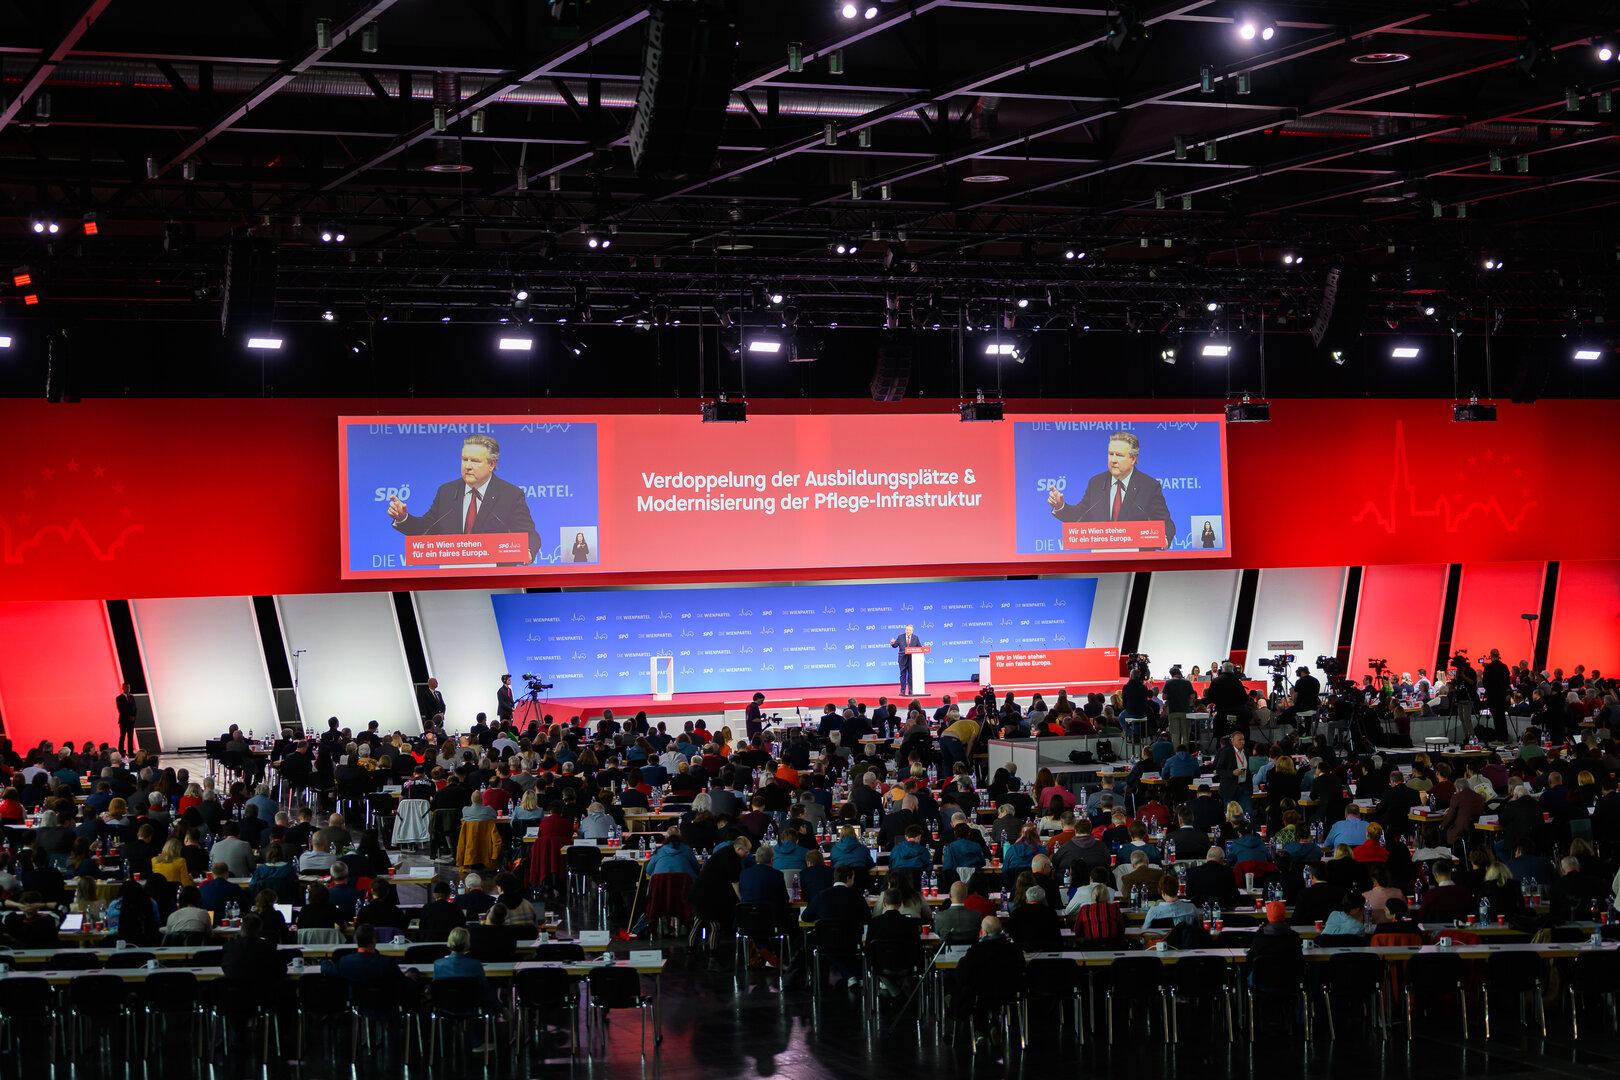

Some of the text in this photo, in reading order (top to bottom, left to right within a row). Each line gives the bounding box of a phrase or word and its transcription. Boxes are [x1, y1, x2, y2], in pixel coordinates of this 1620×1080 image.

[369, 423, 494, 435] DIE WIENPARTEI.
[1032, 422, 1135, 431] DIE WIENPARTEI.
[642, 468, 976, 492] Verdoppelung der Ausbildungsplätze &
[1037, 476, 1067, 492] SPÖ
[375, 484, 411, 502] SPÖ
[637, 489, 982, 515] Modernisierung der Pflege-Infrastruktur
[427, 541, 433, 549] in
[1110, 535, 1133, 543] Europa.
[1035, 540, 1054, 551] DIE
[462, 549, 489, 557] Europa.
[372, 554, 394, 568] DIE
